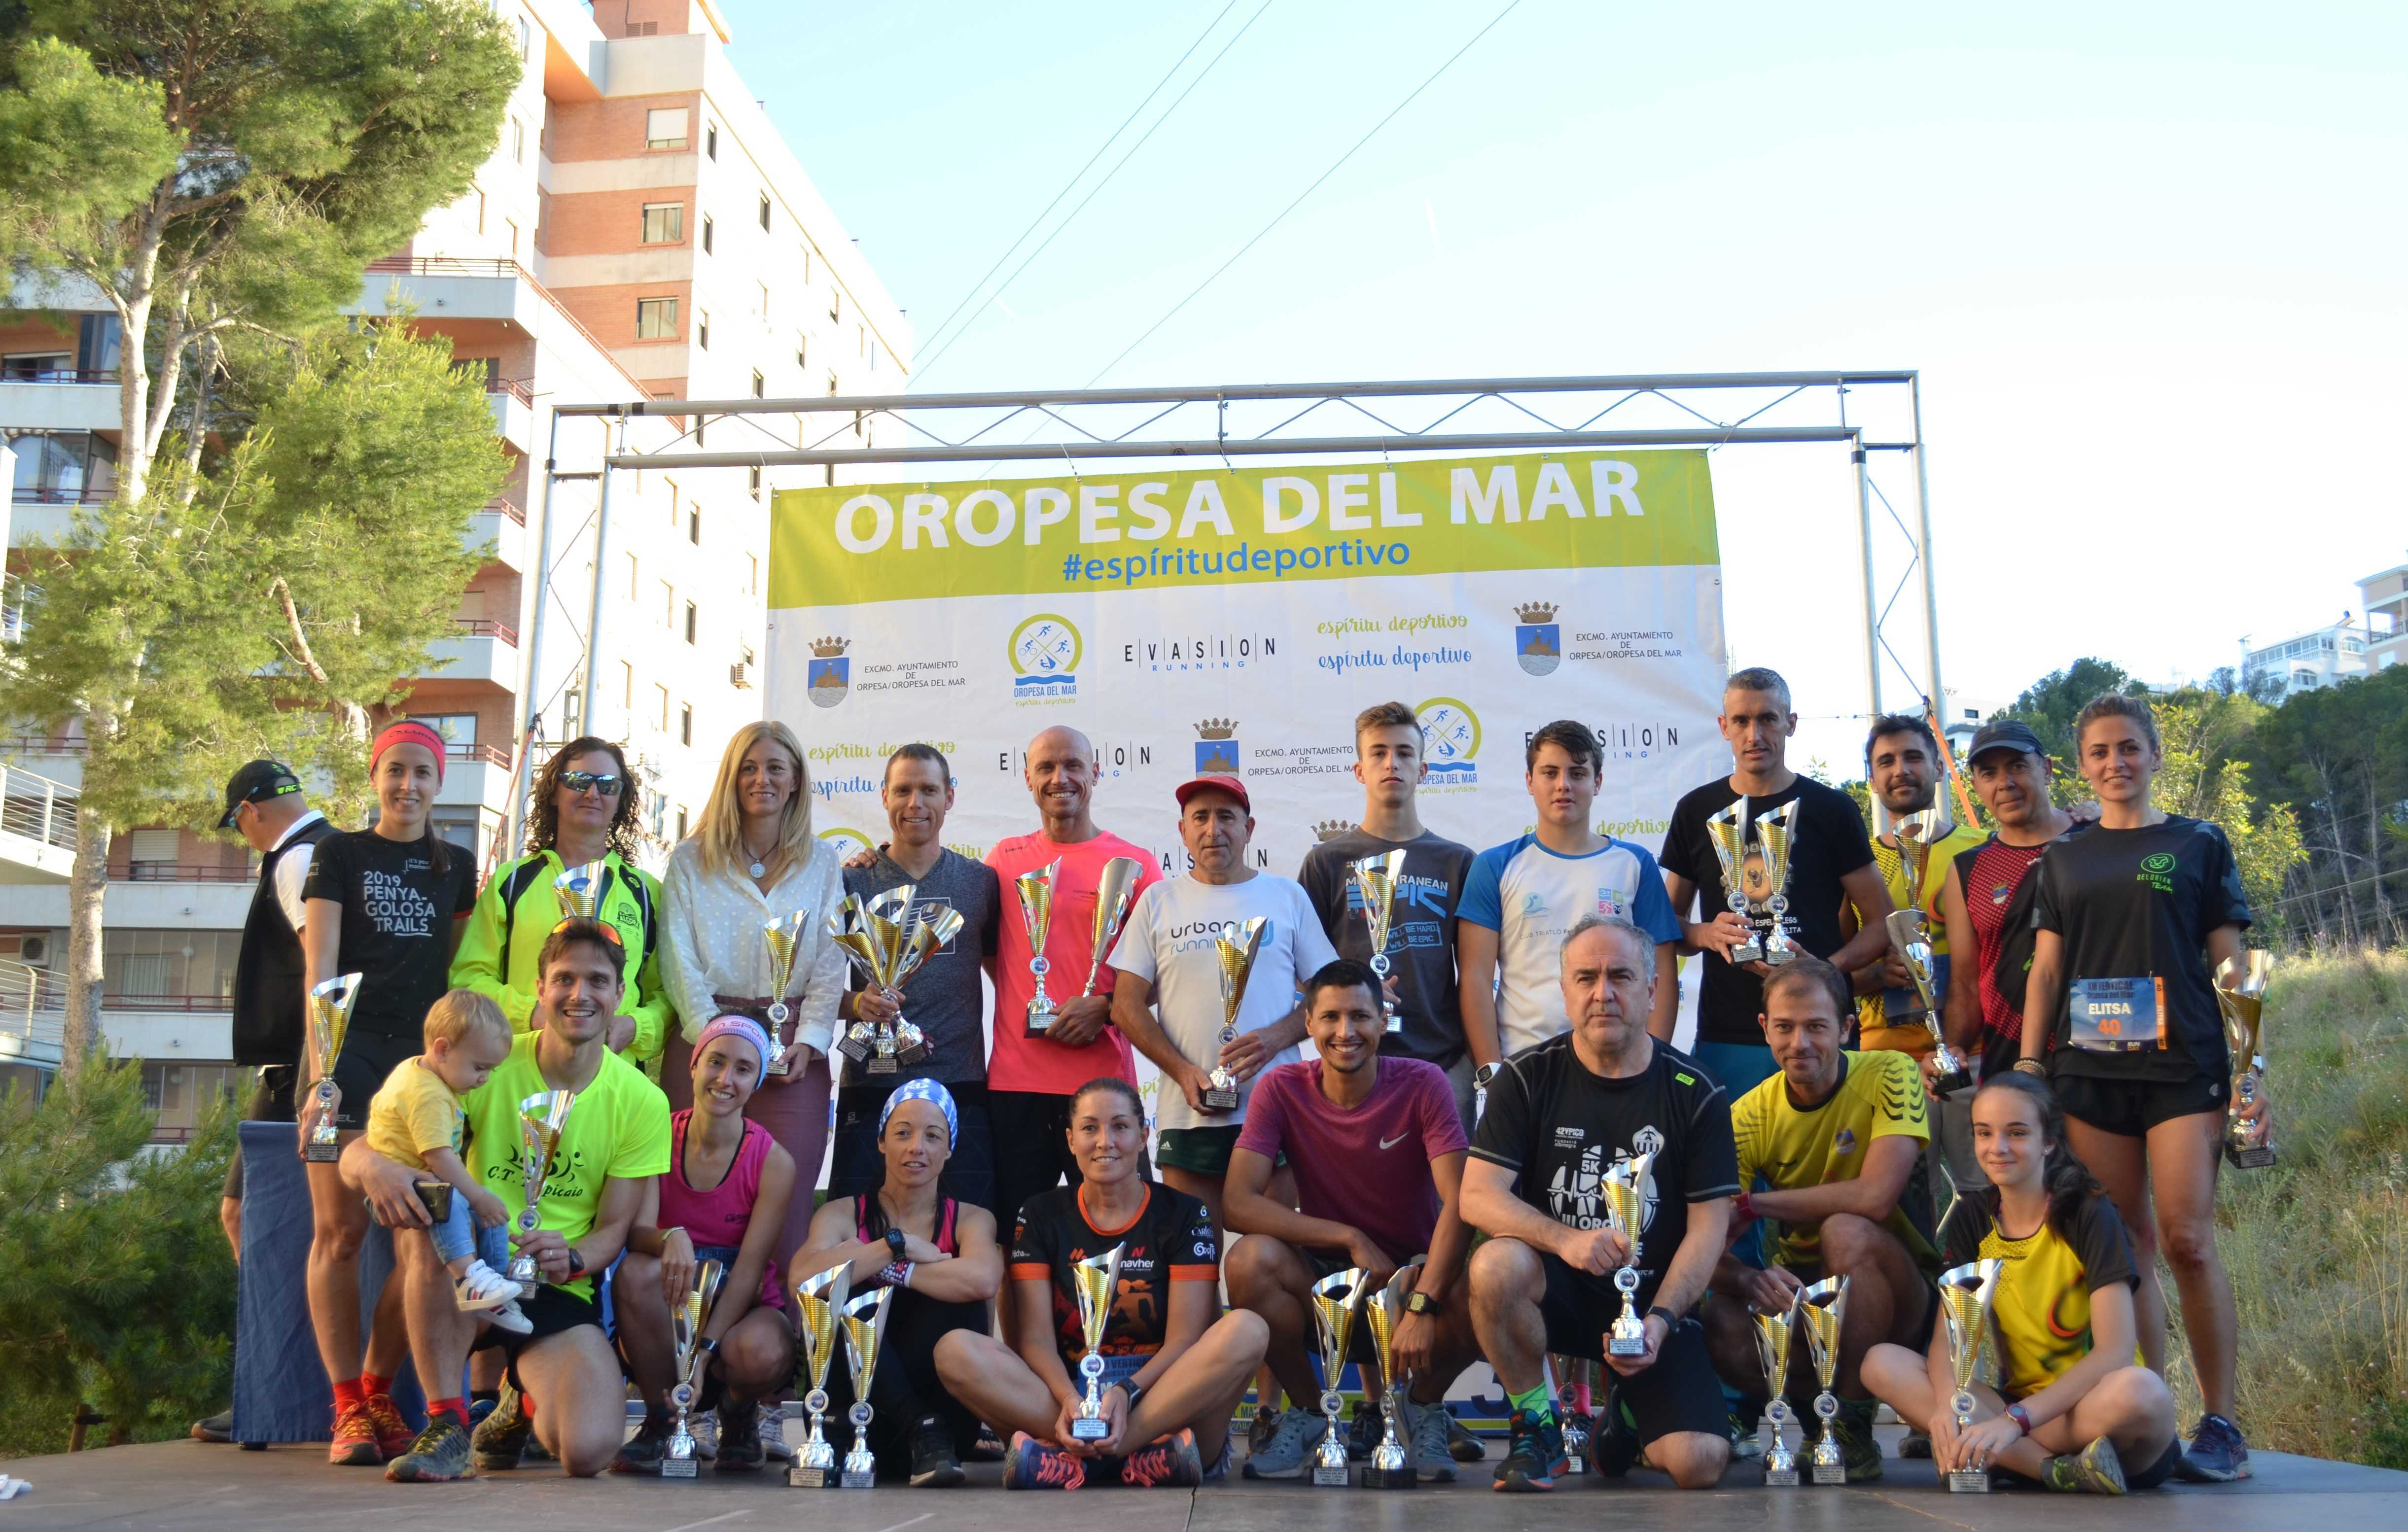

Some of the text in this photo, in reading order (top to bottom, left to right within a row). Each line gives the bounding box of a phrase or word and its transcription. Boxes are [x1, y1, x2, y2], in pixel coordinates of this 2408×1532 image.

[835, 460, 1645, 554] OROPESA DEL MAR
[1062, 538, 1410, 586] #espíritudeportivo
[1317, 614, 1468, 639] espíritu deportivo
[1576, 631, 1673, 641] EXCMO. AYUNTAMIENTO
[1318, 645, 1472, 675] espíritu deportivo
[1569, 650, 1645, 661] ORPESA/OROPESA
[864, 661, 958, 673] EXCMO. AYUNTAMIENTO
[1152, 661, 1245, 672] RUNNING
[856, 680, 929, 691] ORPESA/OROPESA
[948, 678, 966, 686] MAR
[1014, 685, 1077, 697] OROPESA DEL MAR
[808, 742, 872, 766] espíritu
[1255, 745, 1353, 758] EXCMO. AYUNTAMIENTO
[1248, 765, 1324, 776] ORPESA/OROPESA
[1447, 773, 1460, 784] DEL
[1461, 773, 1478, 784] MAR
[363, 870, 401, 887] 2019
[365, 901, 437, 917] GOLOSA
[373, 917, 429, 933] TRAILS
[2088, 1002, 2131, 1015] ELITSA
[2098, 1018, 2121, 1036] 40
[1581, 1160, 1600, 1174] 5K
[1120, 1258, 1155, 1268] navher
